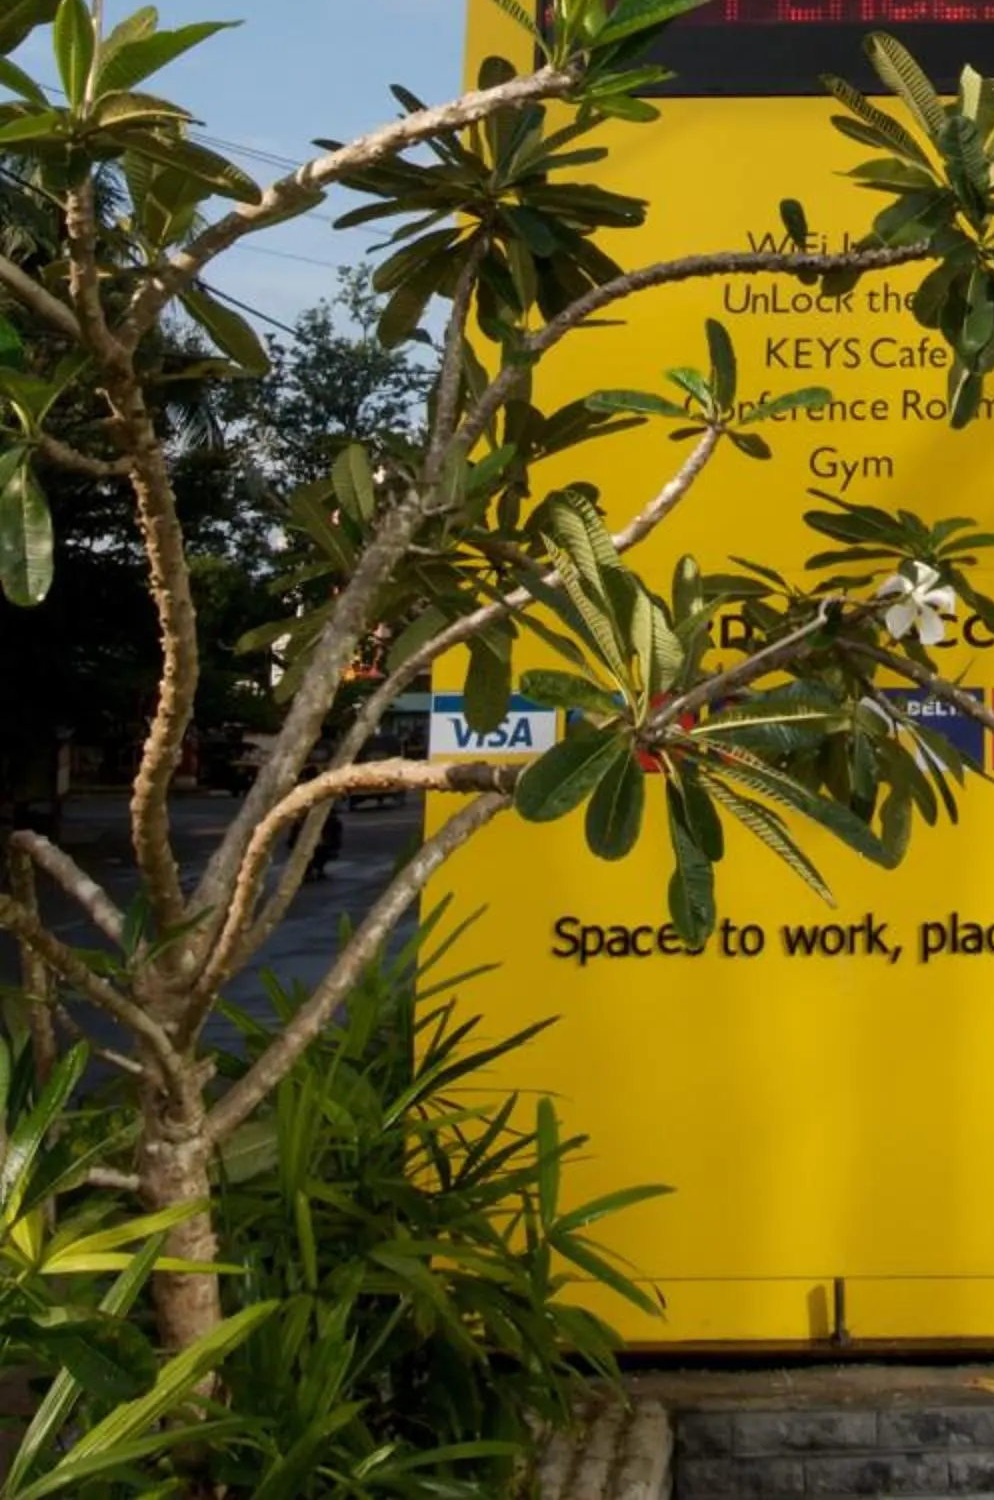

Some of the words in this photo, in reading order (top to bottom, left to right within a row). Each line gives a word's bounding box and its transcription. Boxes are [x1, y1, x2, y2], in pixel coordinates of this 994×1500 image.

[723, 283, 853, 313] UnLock
[766, 338, 861, 369] KEYS
[871, 337, 947, 369] Cafe
[809, 446, 894, 491] Gym
[907, 700, 966, 717] DELT
[552, 916, 706, 966] Space
[720, 918, 765, 956] to
[784, 913, 902, 964] work,
